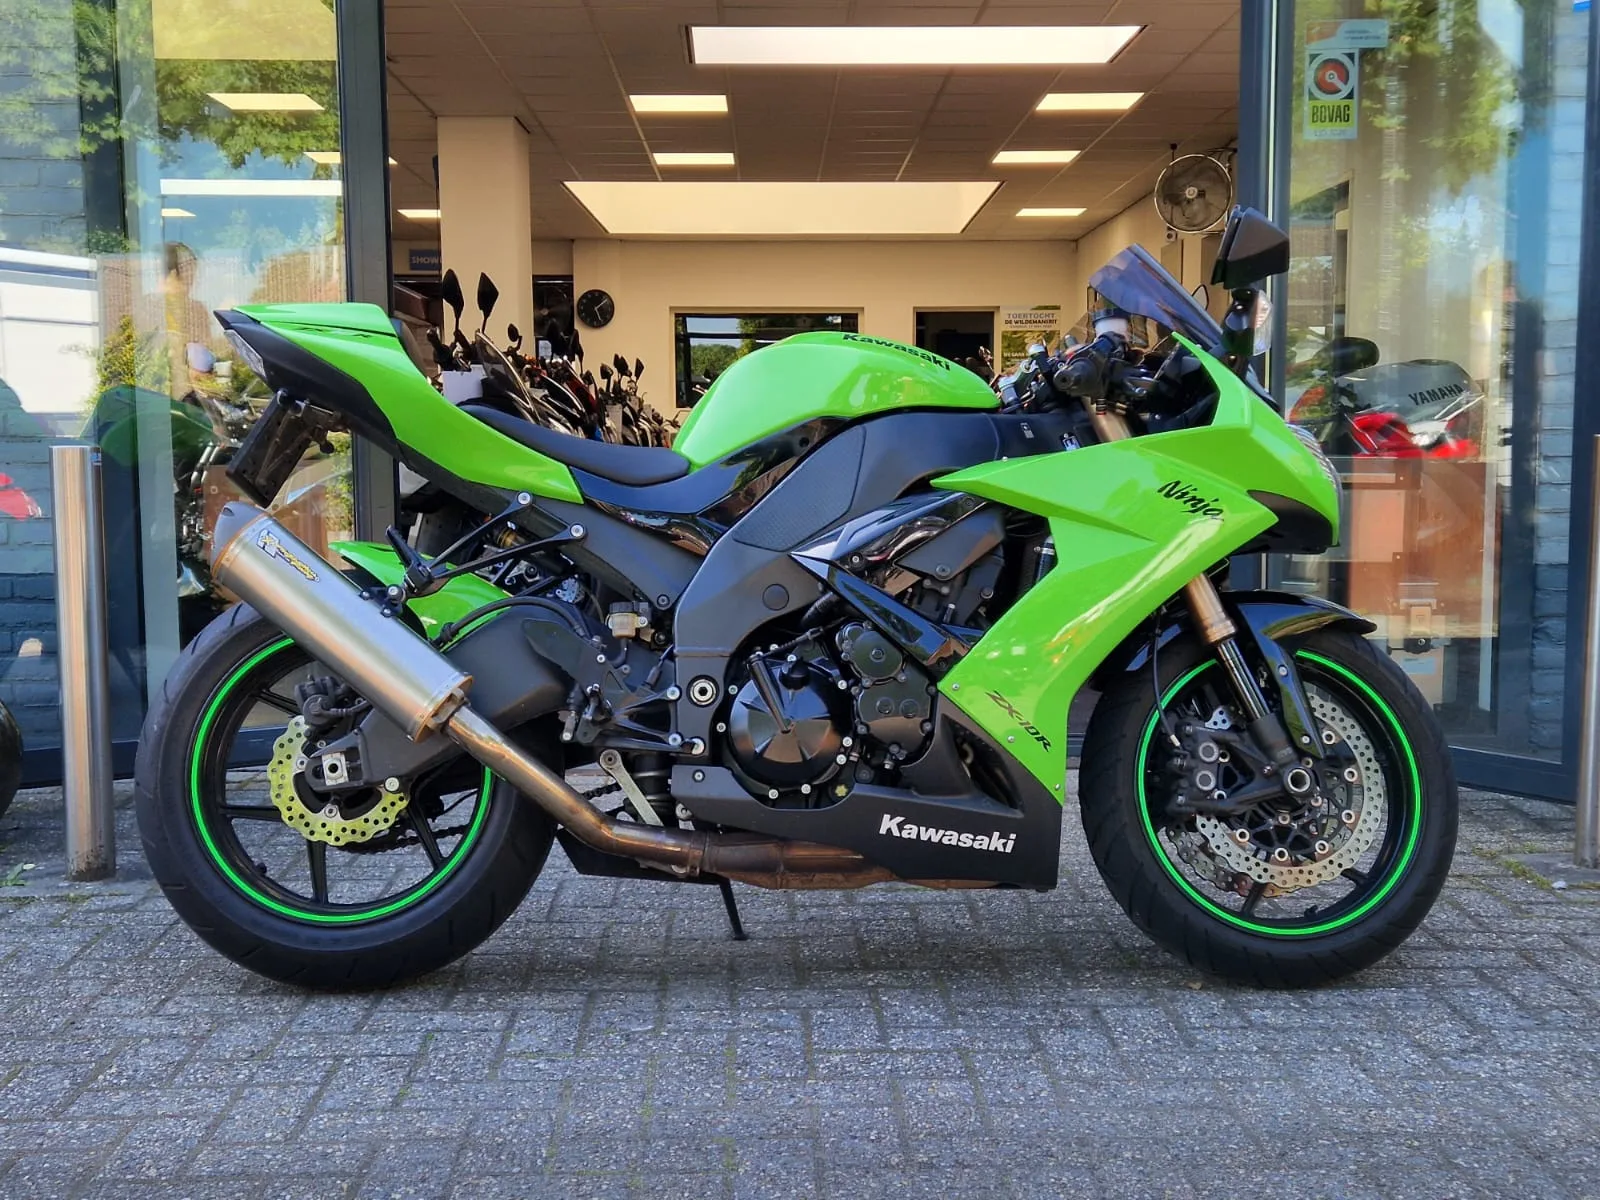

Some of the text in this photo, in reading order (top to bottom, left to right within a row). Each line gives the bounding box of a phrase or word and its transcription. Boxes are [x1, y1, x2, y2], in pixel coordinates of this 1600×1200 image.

[1311, 104, 1350, 123] BOVAG
[411, 256, 442, 264] SHOW
[842, 333, 951, 371] Kawasaki
[1408, 383, 1464, 406] YAMAHA
[1157, 480, 1224, 521] Ninja
[985, 689, 1051, 752] ZX-10R
[879, 813, 1017, 853] Kawasaki
